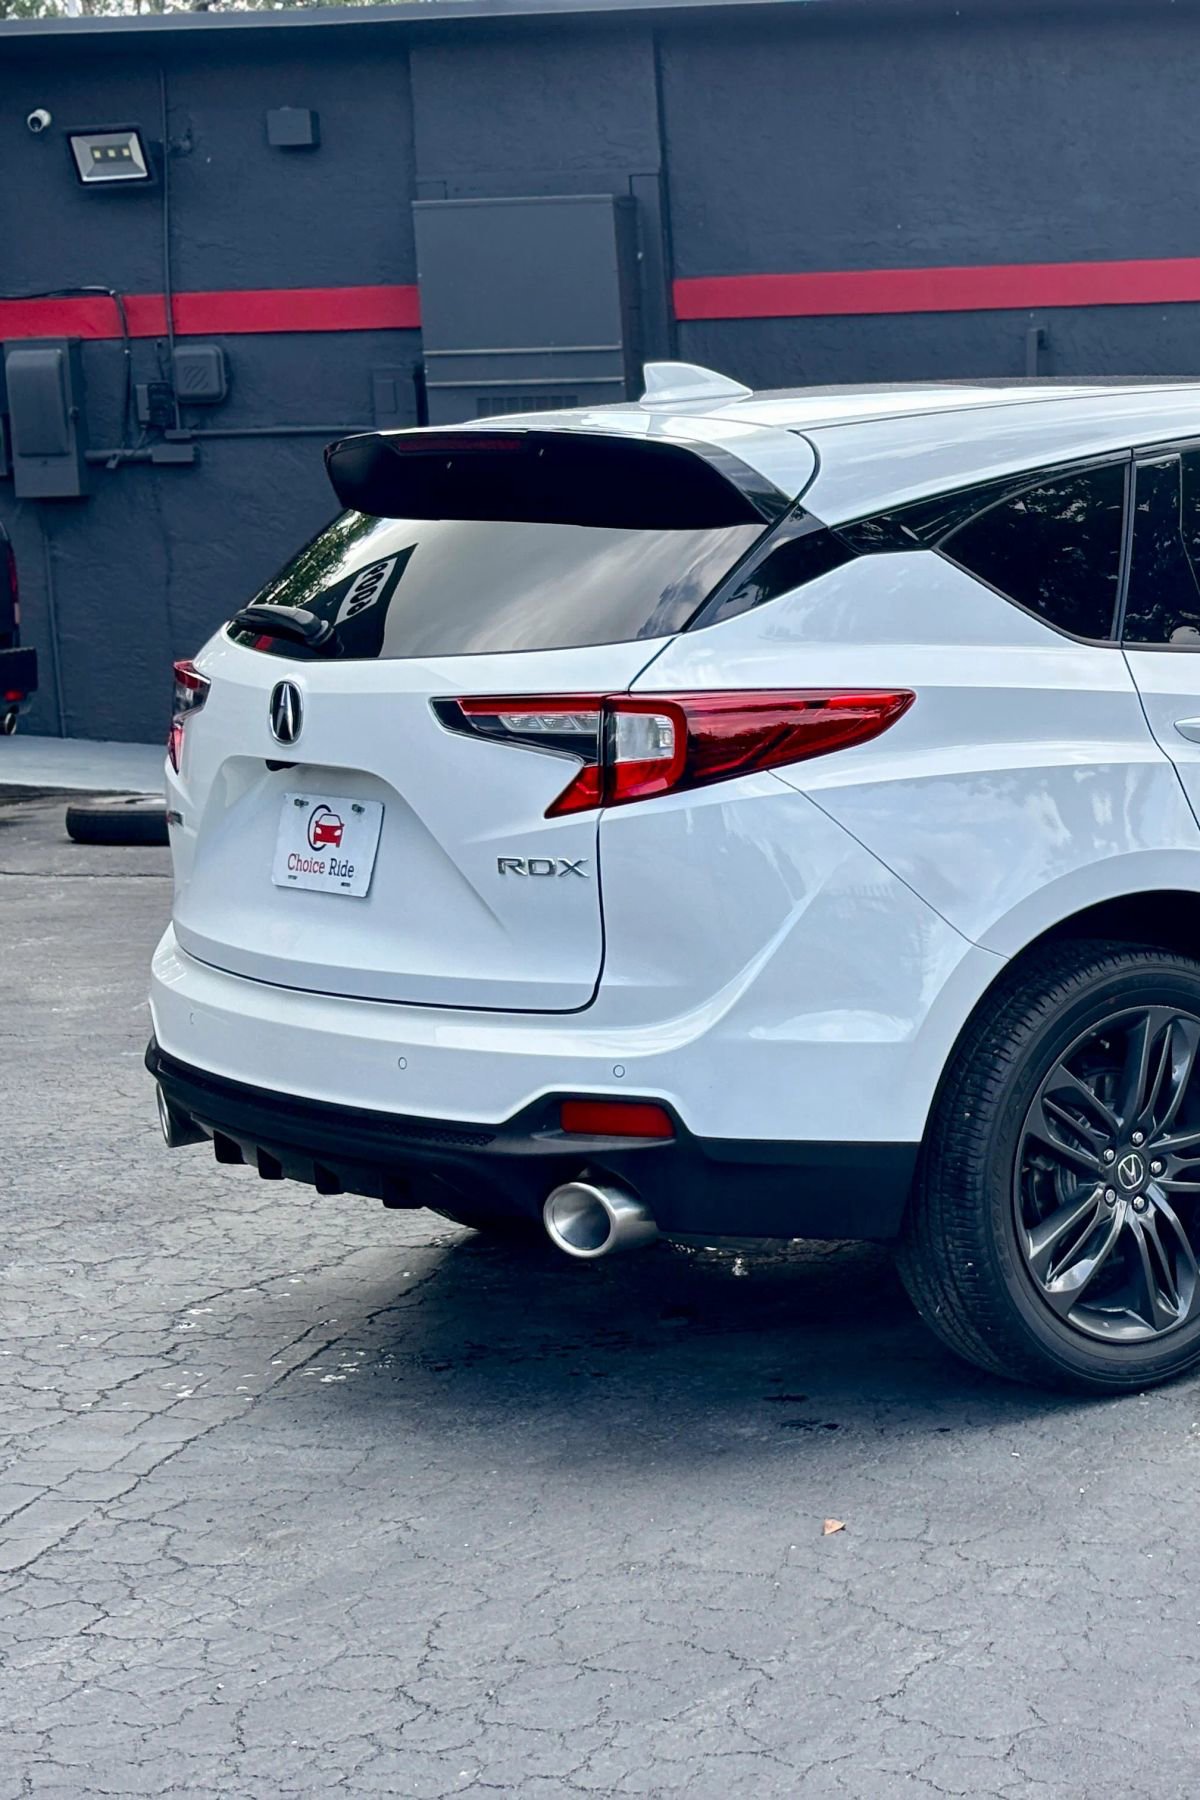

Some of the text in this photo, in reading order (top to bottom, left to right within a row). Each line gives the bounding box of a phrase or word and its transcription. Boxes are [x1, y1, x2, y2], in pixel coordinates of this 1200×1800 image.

[287, 853, 355, 878] Choice Ride
[497, 856, 590, 878] RDX
